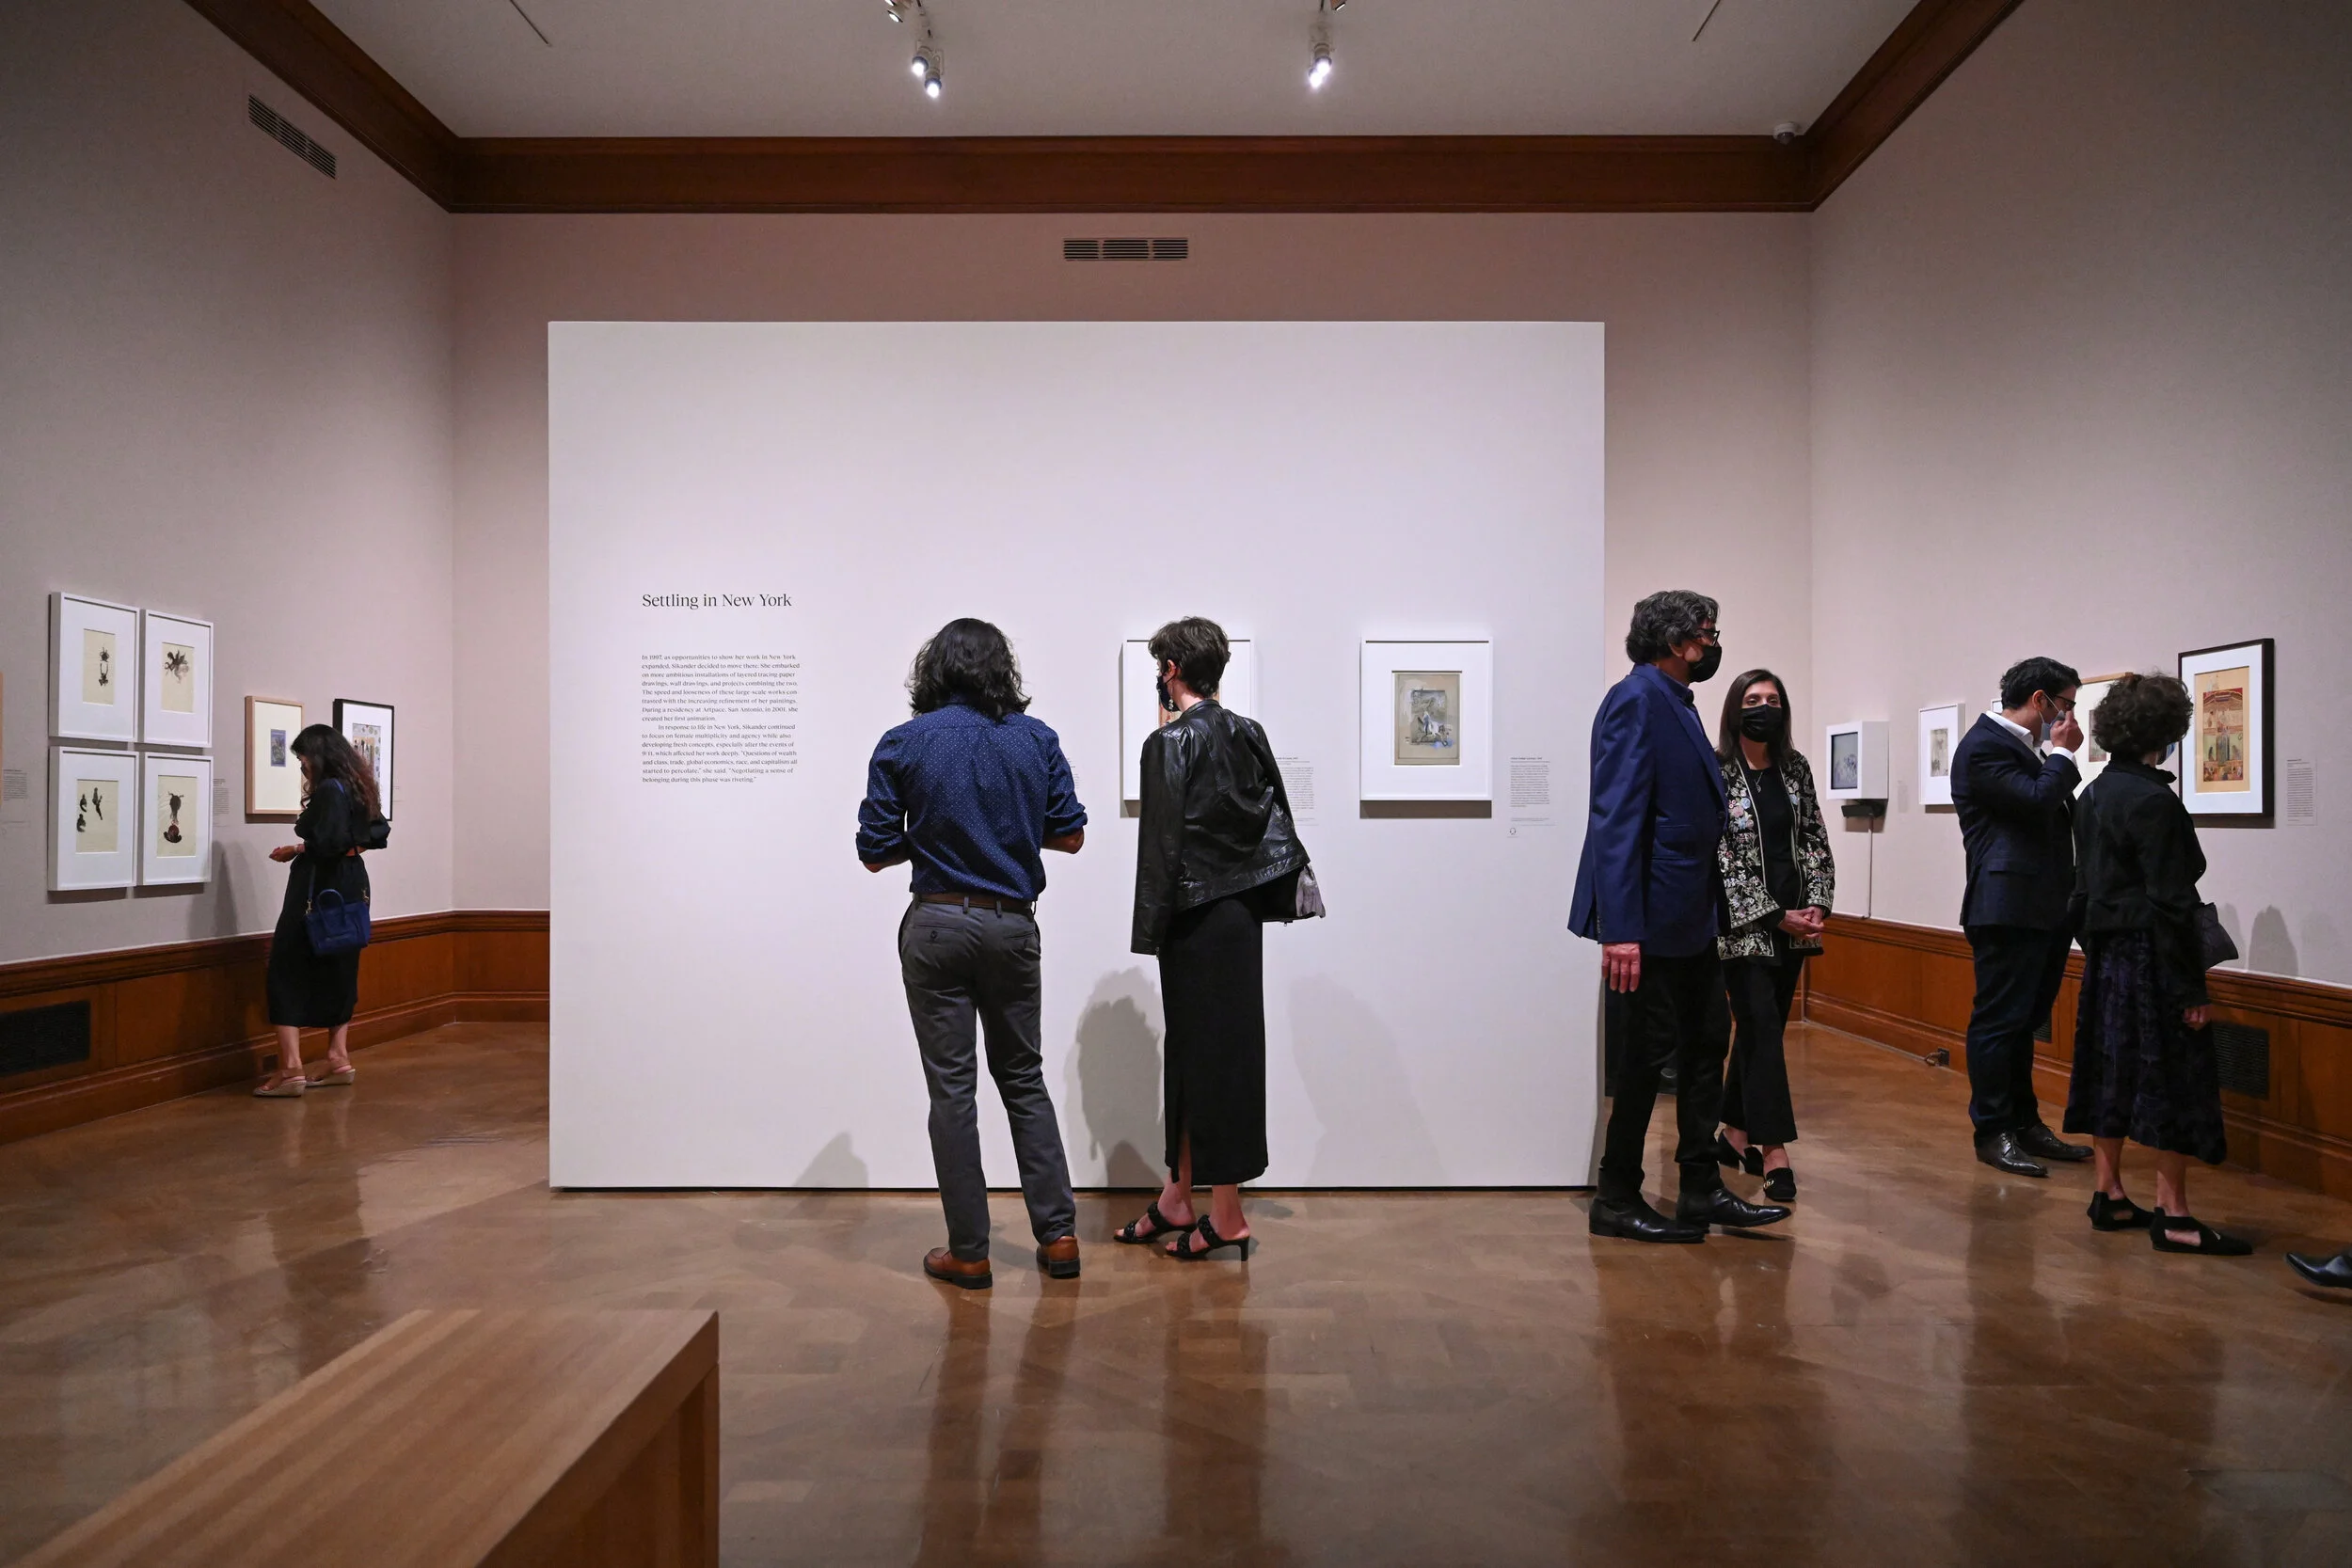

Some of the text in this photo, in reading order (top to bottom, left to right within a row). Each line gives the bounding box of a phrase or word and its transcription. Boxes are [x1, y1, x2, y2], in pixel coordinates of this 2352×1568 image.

[642, 593, 792, 610] Settling in New York
